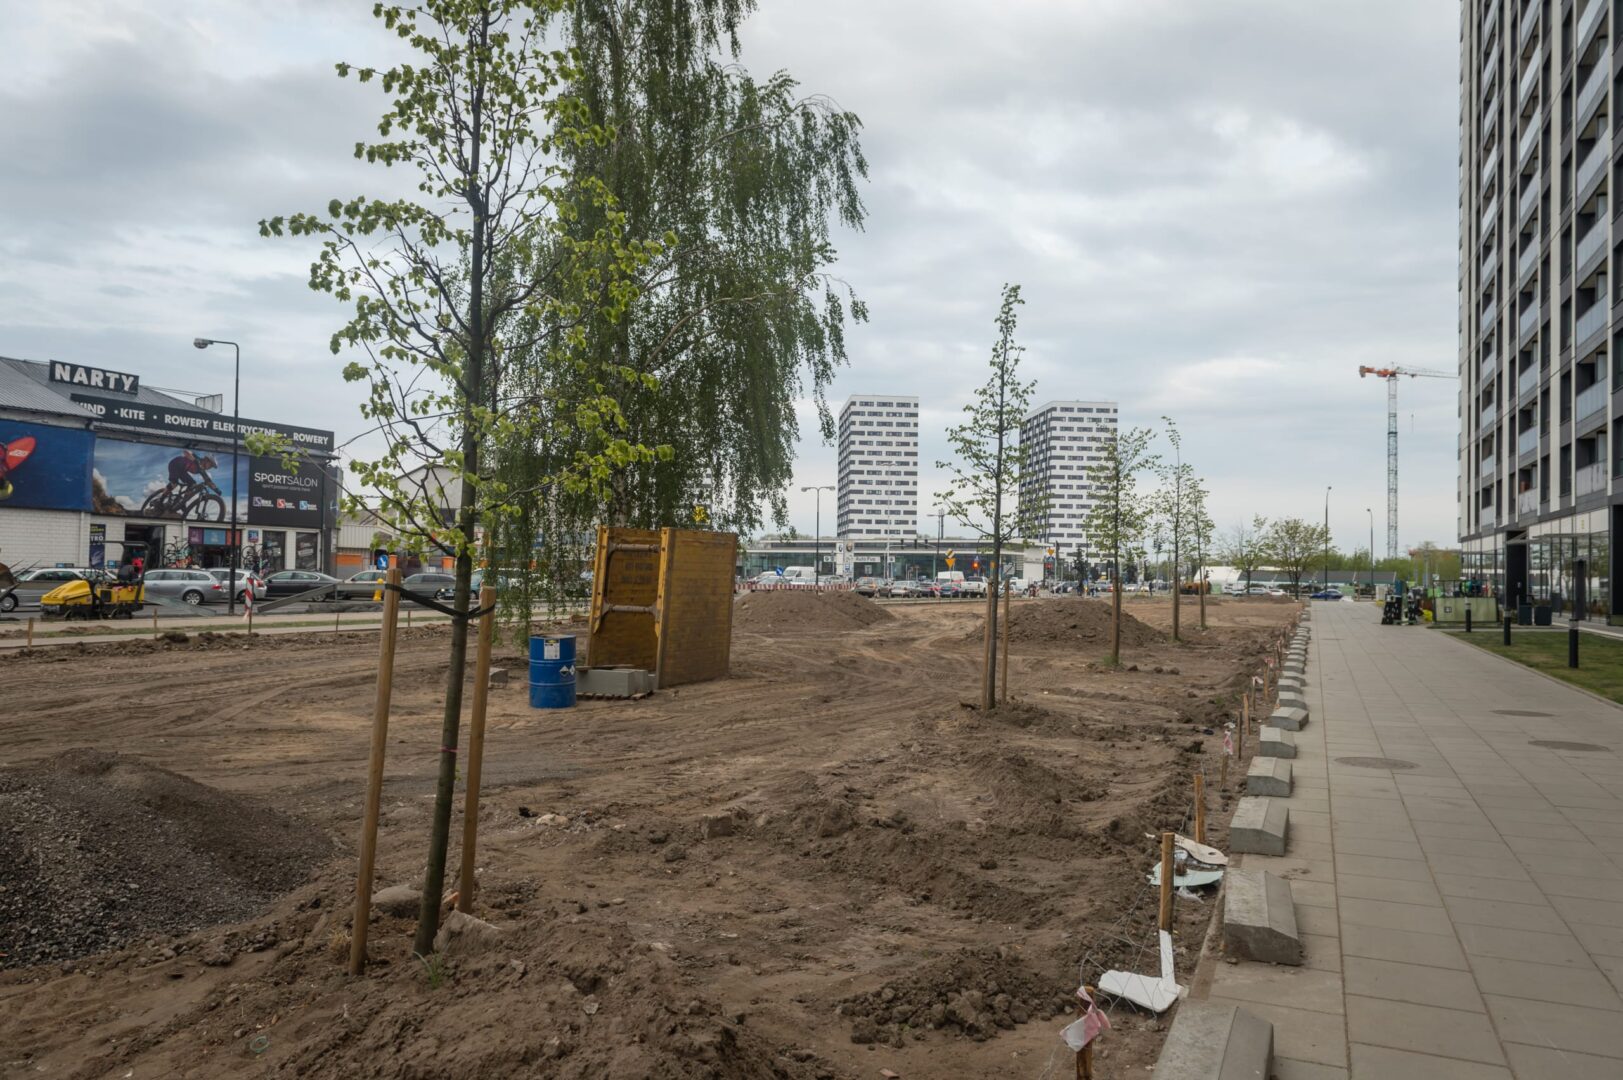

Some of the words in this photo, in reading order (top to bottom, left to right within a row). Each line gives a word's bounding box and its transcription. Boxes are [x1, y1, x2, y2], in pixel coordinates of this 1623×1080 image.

[55, 363, 134, 391] NARTY
[120, 408, 145, 420] KITE
[164, 414, 209, 429] ROWERY
[293, 432, 329, 444] ROWERY
[254, 472, 318, 487] SPORTSALON
